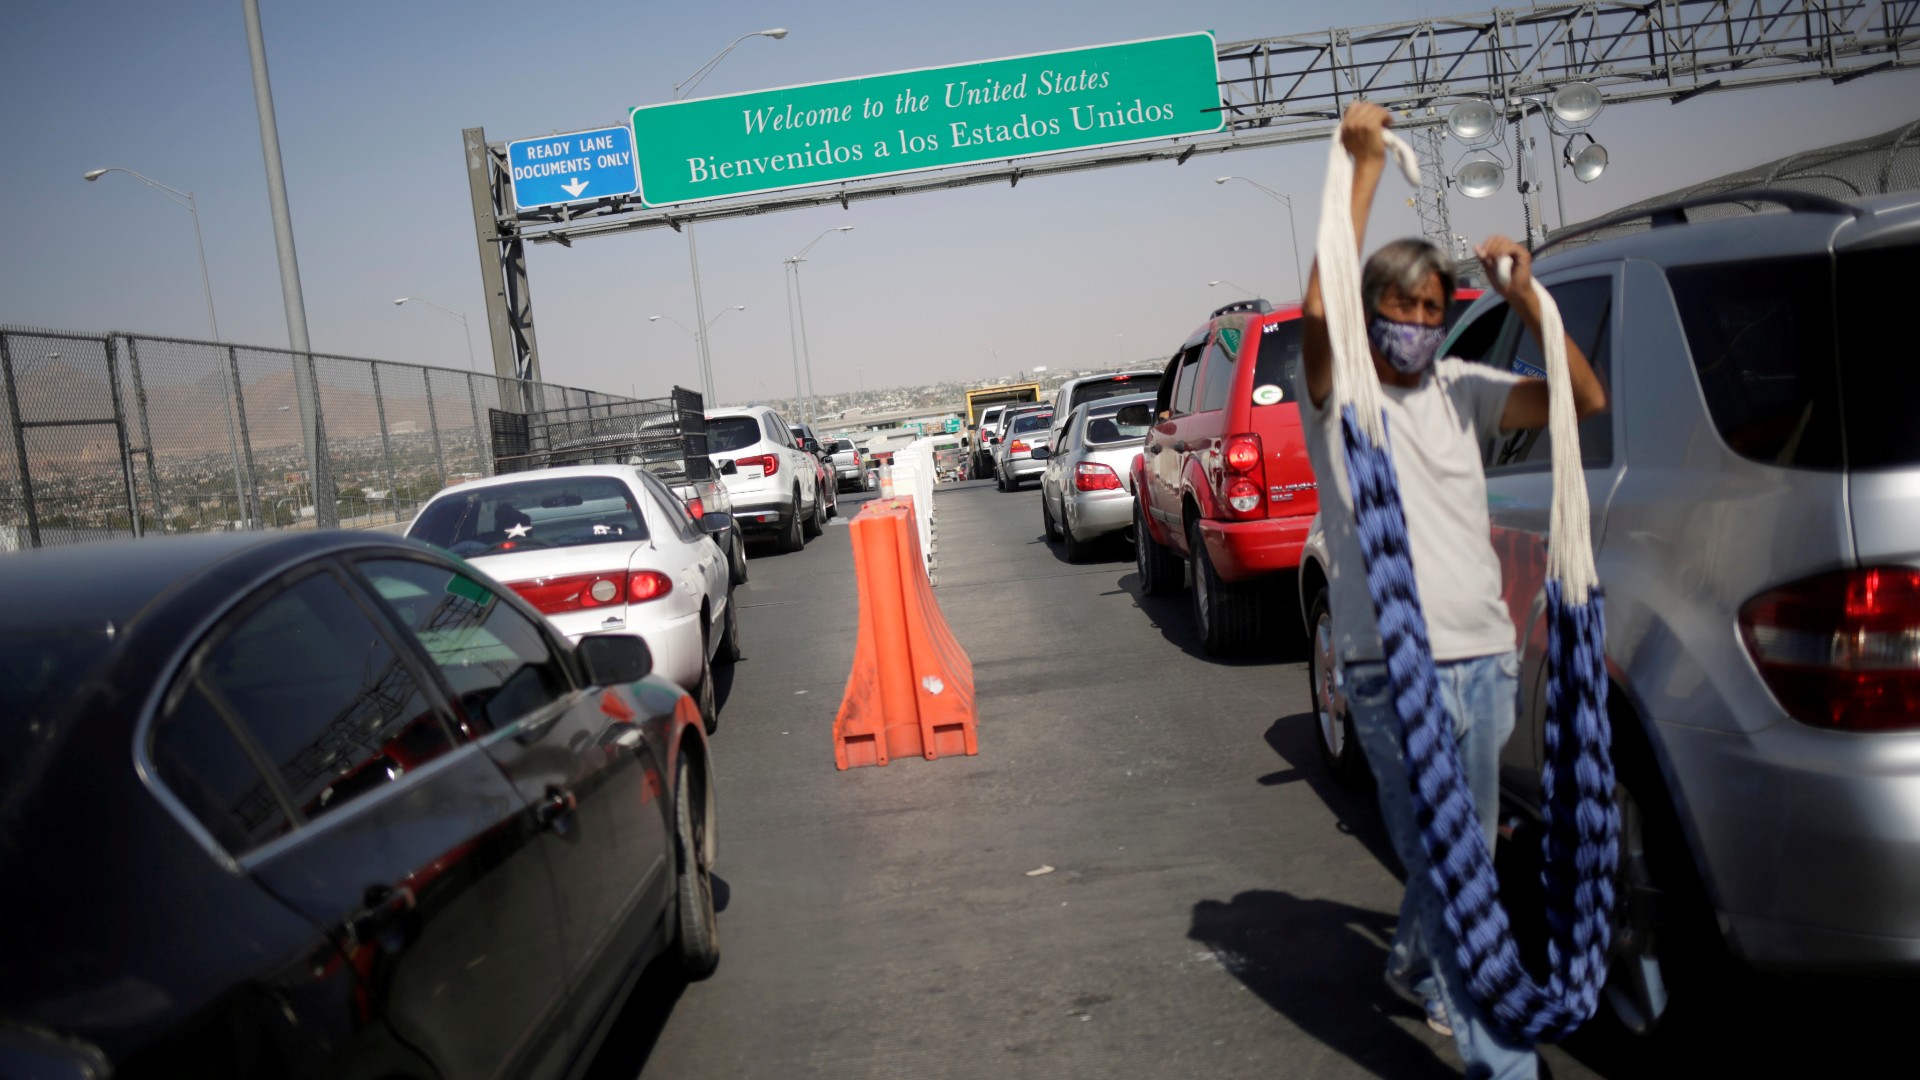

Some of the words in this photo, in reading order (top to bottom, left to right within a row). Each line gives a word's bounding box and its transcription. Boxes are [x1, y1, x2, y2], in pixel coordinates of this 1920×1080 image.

[743, 106, 852, 135] Welcome
[864, 98, 884, 118] to
[895, 89, 929, 115] the
[944, 74, 1027, 108] United
[1037, 70, 1109, 96] States
[527, 141, 570, 160] READY
[580, 135, 614, 153] LANE
[687, 140, 863, 183] Bienvenidos
[874, 142, 890, 158] a
[898, 130, 939, 154] los
[949, 114, 1060, 148] Estados
[1068, 99, 1174, 132] Unidos
[514, 157, 591, 181] DOCUMENTS
[597, 151, 630, 169] ONLY
